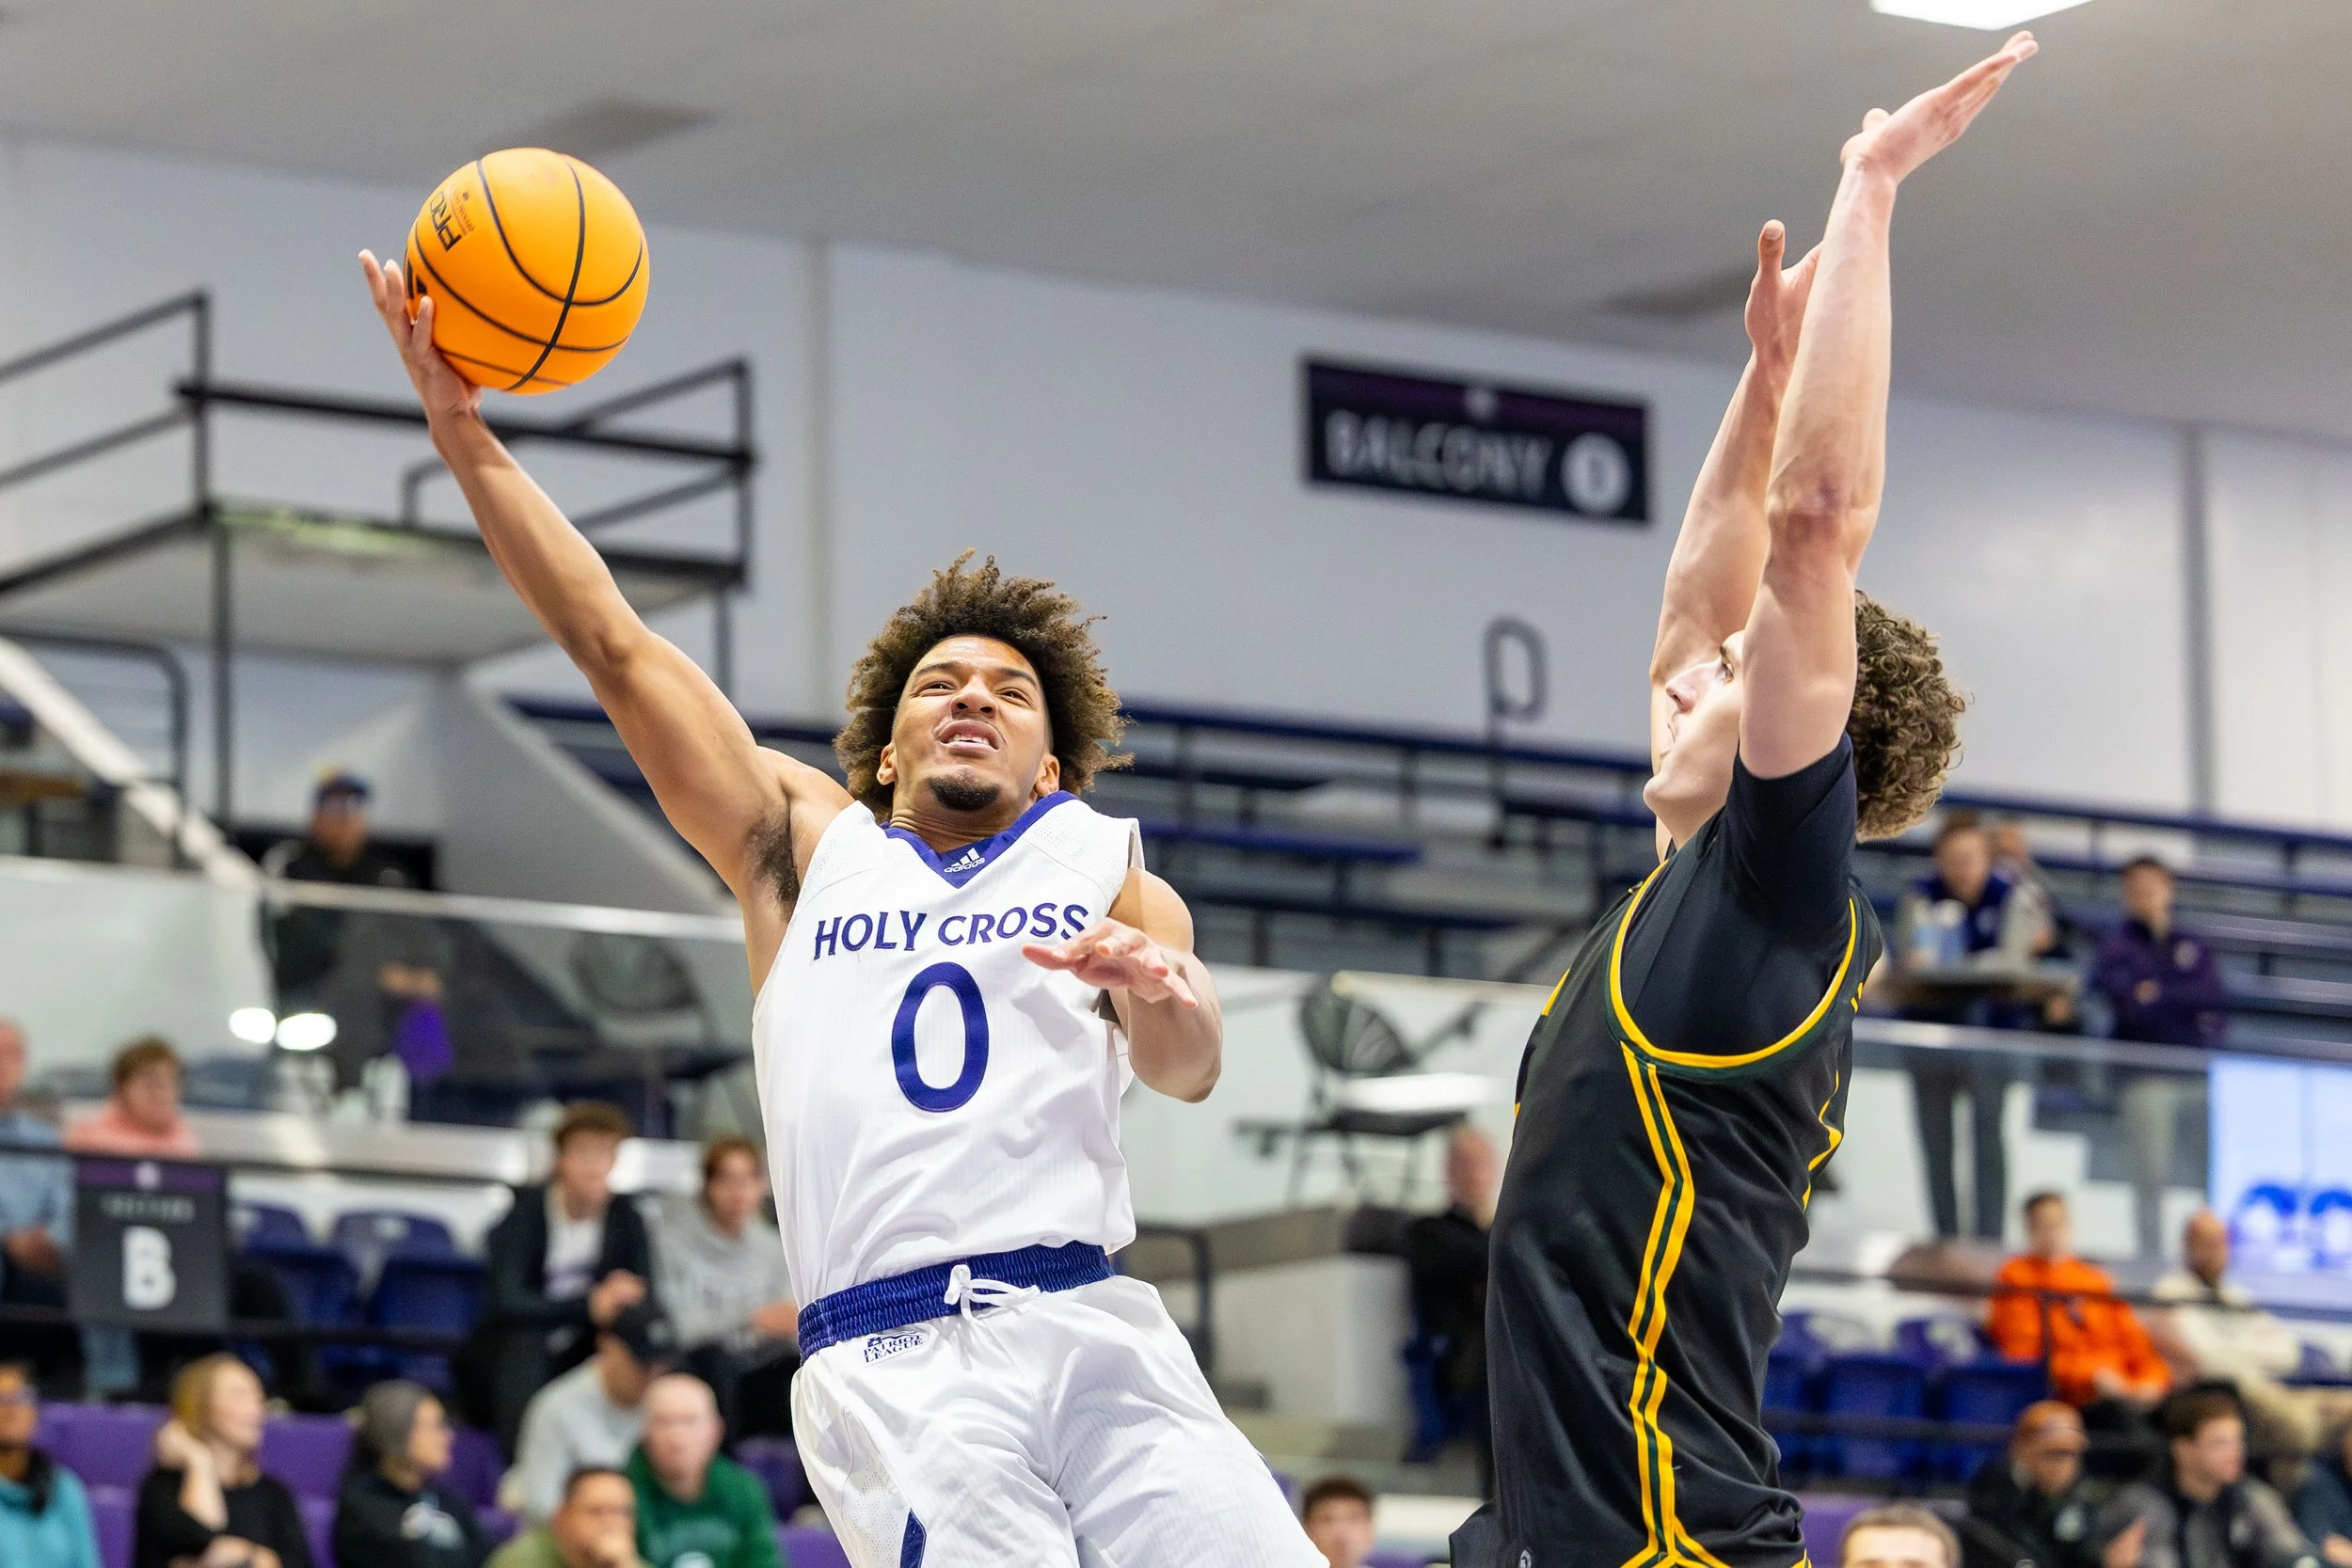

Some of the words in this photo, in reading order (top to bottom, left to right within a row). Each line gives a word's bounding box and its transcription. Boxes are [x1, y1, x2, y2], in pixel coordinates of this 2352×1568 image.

[1325, 408, 1555, 499] BALCONY
[943, 857, 986, 873] adidas
[813, 910, 928, 960] HOLY
[937, 901, 1089, 946] CROSS
[891, 961, 990, 1113] 0
[120, 1224, 178, 1311] B
[864, 1335, 922, 1356] PATRIOT
[865, 1338, 924, 1363] LEAGUE
